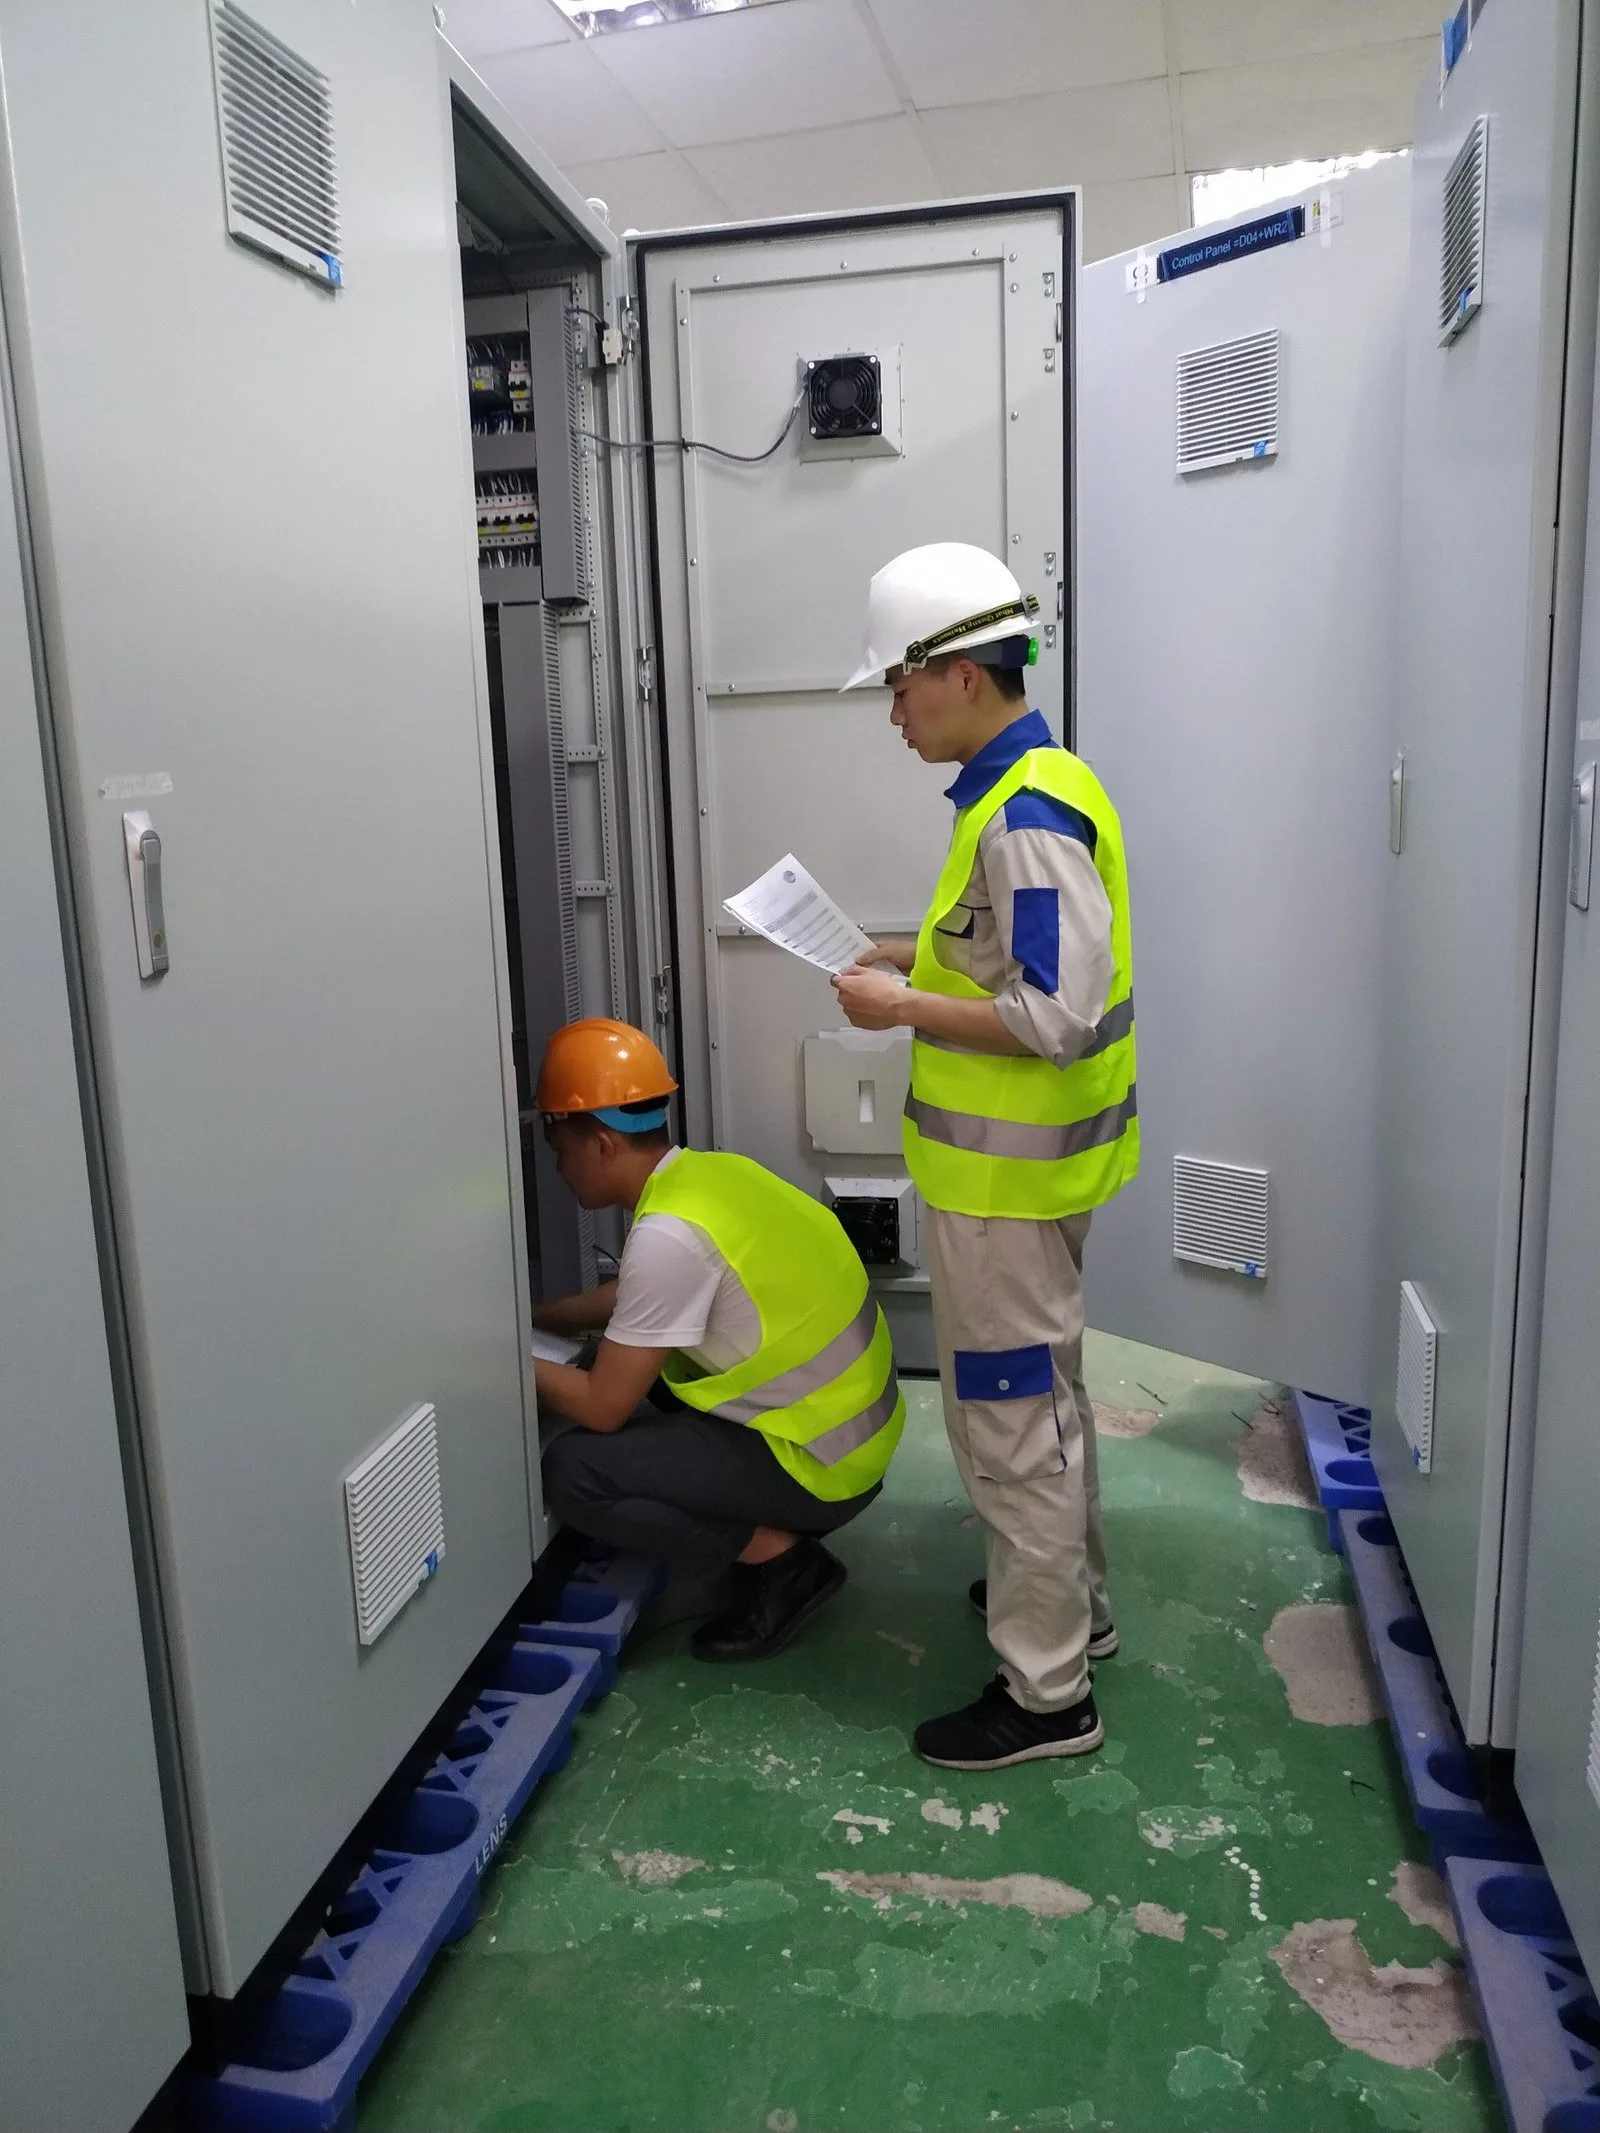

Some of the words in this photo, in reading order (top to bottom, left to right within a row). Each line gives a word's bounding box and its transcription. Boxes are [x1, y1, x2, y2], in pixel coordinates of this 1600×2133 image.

[1172, 249, 1203, 269] Control
[1205, 241, 1231, 258] Panel
[1233, 221, 1288, 248] =D04+WR2
[475, 1813, 508, 1875] LENS
